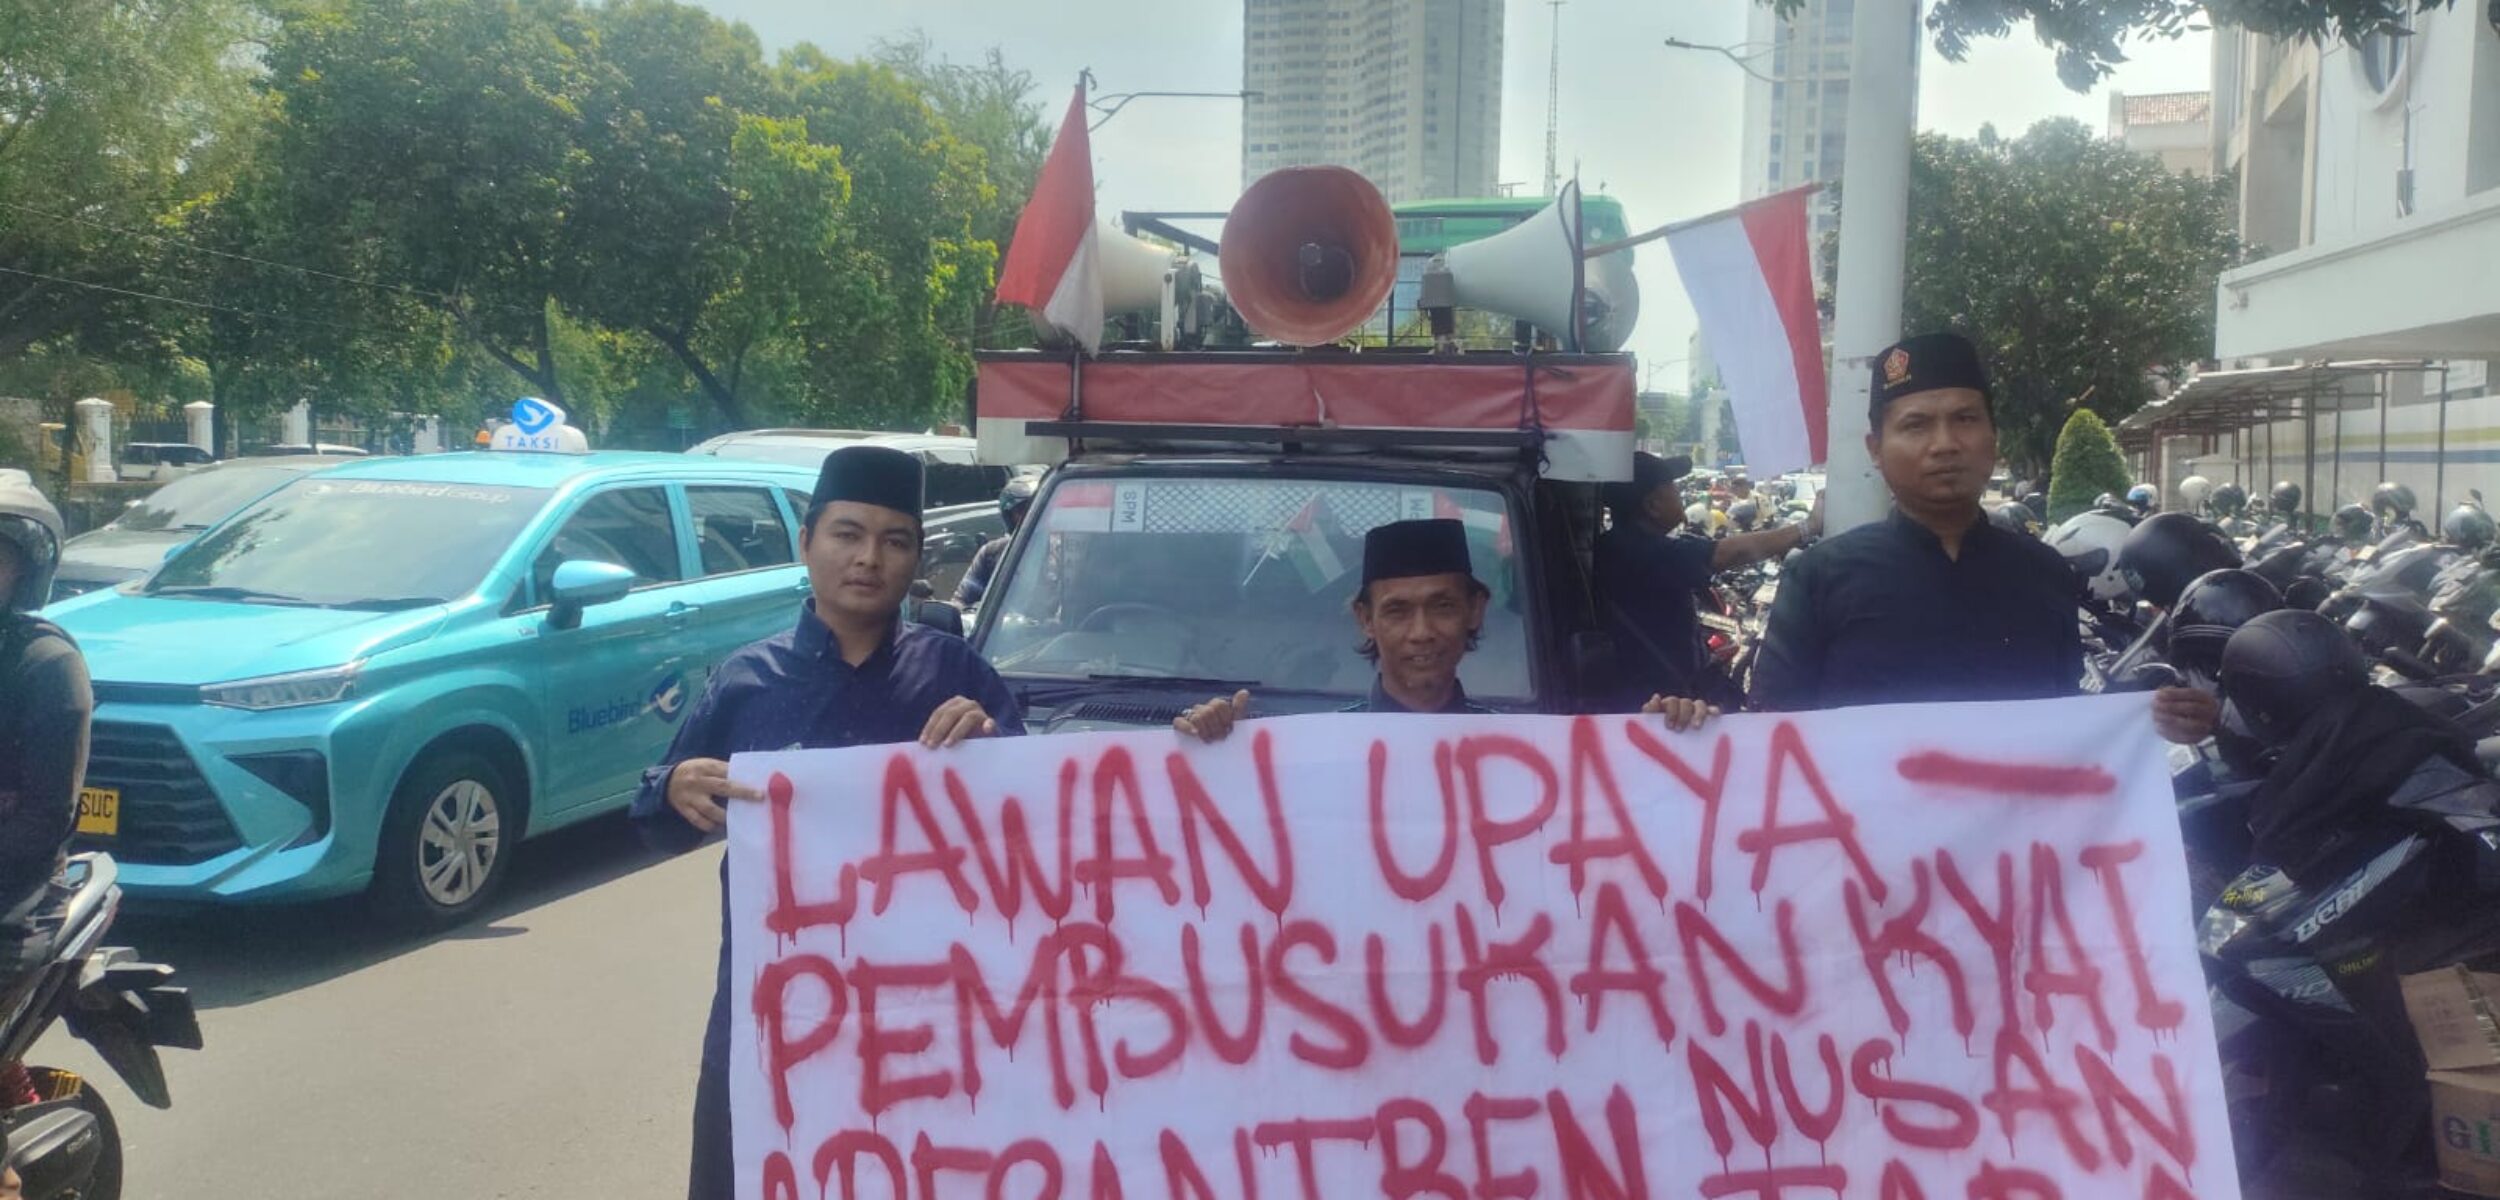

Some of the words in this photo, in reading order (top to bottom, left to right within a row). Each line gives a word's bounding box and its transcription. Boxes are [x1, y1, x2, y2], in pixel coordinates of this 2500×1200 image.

[505, 435, 560, 450] TAKSI
[1120, 490, 1137, 524] SPM
[568, 691, 643, 734] Bluebird
[79, 792, 114, 818] SUC
[767, 729, 1293, 934] LAWAN
[1369, 715, 1887, 908] UPAYA
[753, 883, 1808, 1130] PEMBUSUKAN
[1844, 840, 2185, 1053] KYAI
[1686, 1020, 2198, 1172] NUSAN
